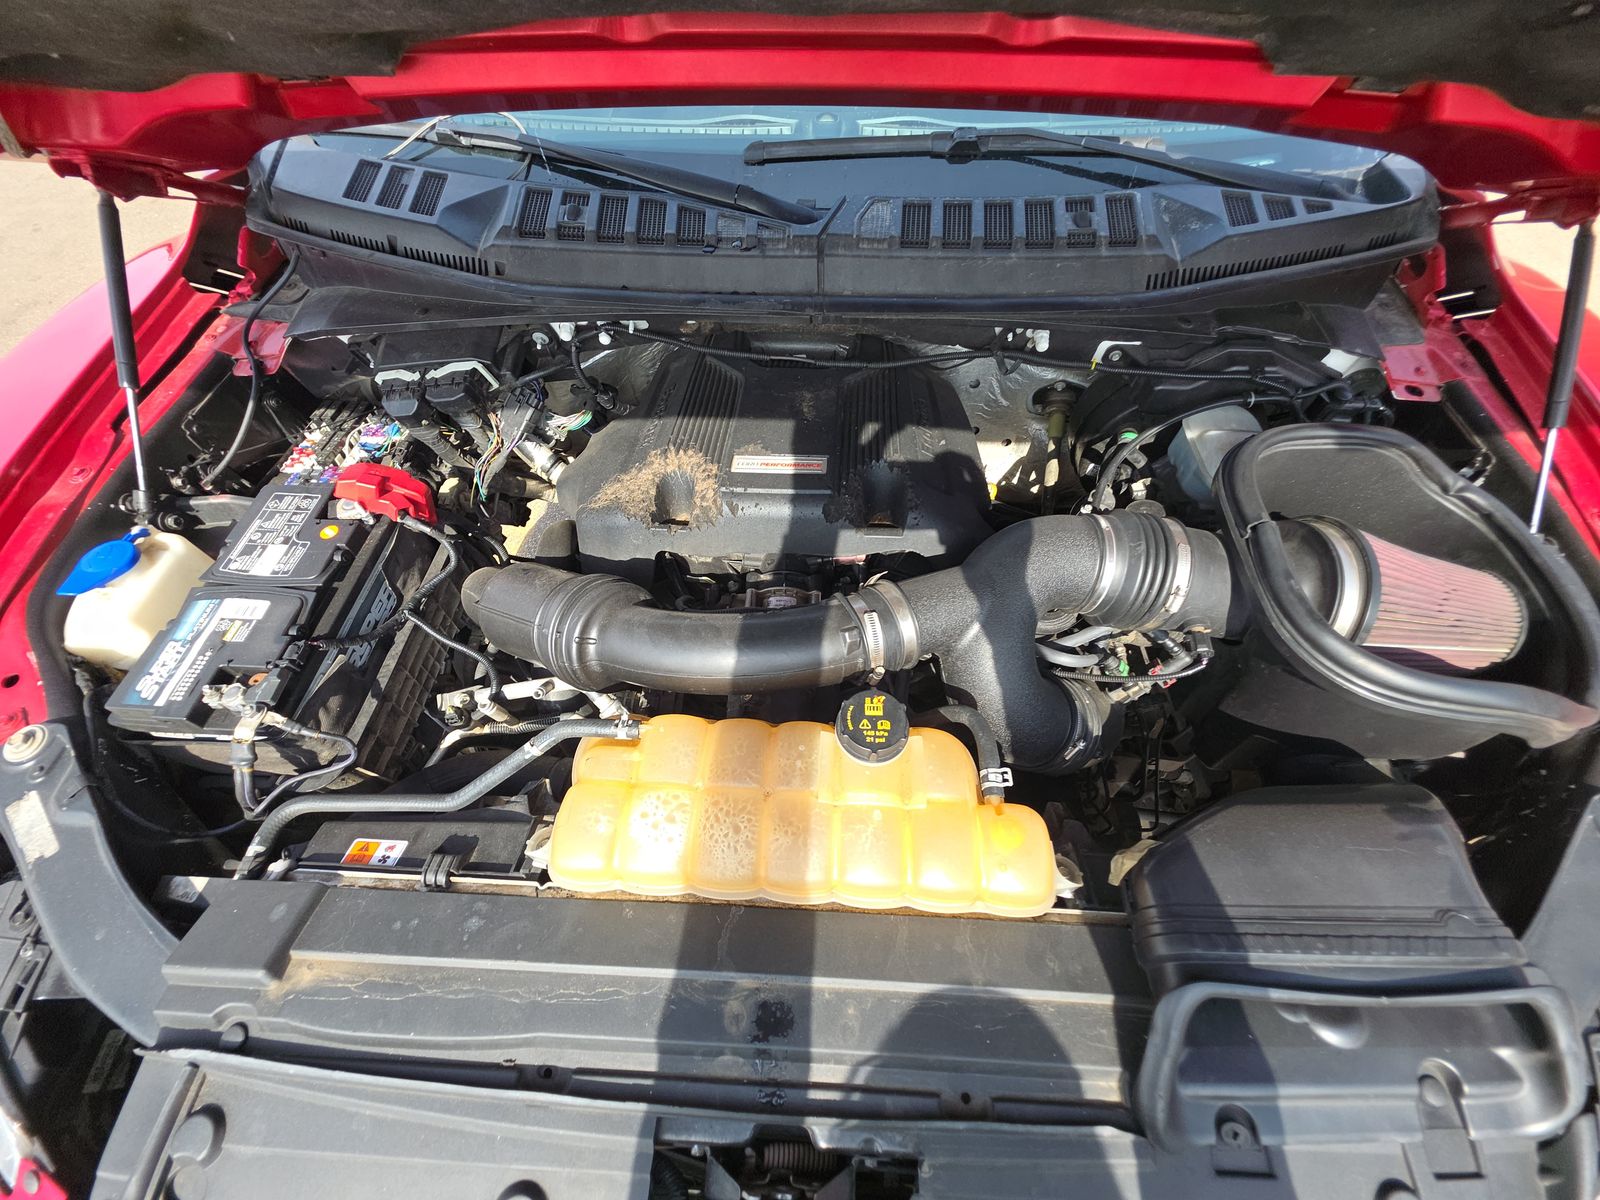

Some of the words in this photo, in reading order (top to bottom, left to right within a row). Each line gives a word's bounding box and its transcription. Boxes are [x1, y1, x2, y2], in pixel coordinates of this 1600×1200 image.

[759, 461, 823, 470] PERFORMANCE
[135, 641, 182, 692] SUPER
[140, 644, 189, 700] START
